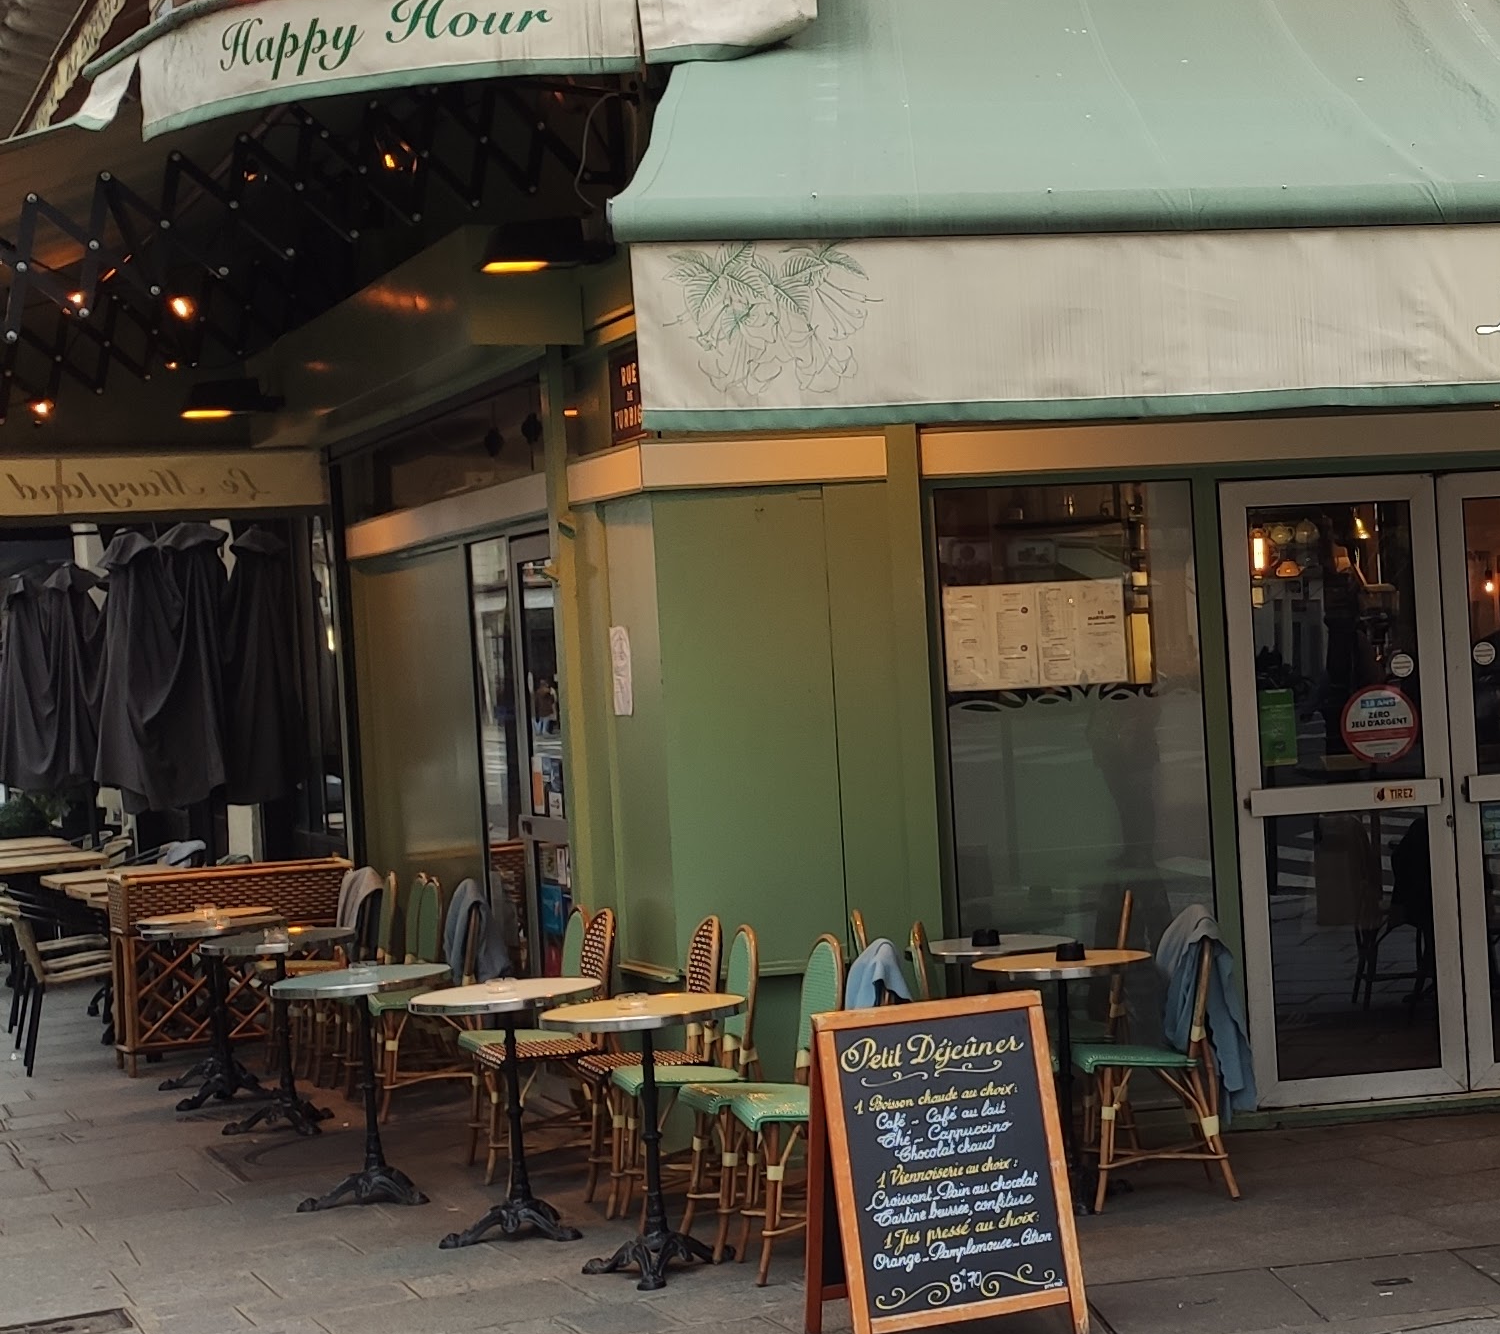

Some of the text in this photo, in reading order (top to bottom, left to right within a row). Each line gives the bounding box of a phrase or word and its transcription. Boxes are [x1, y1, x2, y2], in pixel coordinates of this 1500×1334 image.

[220, 18, 365, 81] Happy
[1351, 717, 1408, 729] JEU D'ARGENT
[1390, 787, 1413, 800] TIREZ
[841, 1038, 903, 1073] Petit
[854, 1100, 864, 1115] 1
[869, 1094, 915, 1112] Boisson
[917, 1086, 958, 1105] chaude
[961, 1087, 978, 1099] au
[876, 1111, 906, 1132] Café
[926, 1104, 958, 1128] Café
[961, 1108, 978, 1118] au
[981, 1098, 1006, 1117] lait
[928, 1121, 1013, 1143] Cappuccino
[895, 1135, 997, 1162] Chocolat chaud
[876, 1170, 886, 1189] 1
[890, 1164, 964, 1186] Viennoiserie
[965, 1163, 979, 1175] au
[972, 1182, 989, 1193] au
[990, 1169, 1038, 1192] chocolat
[873, 1205, 927, 1227] Tartine
[974, 1190, 1034, 1213] confiture
[894, 1228, 922, 1255] Jus
[926, 1218, 972, 1247] pressé
[974, 1219, 997, 1233] au
